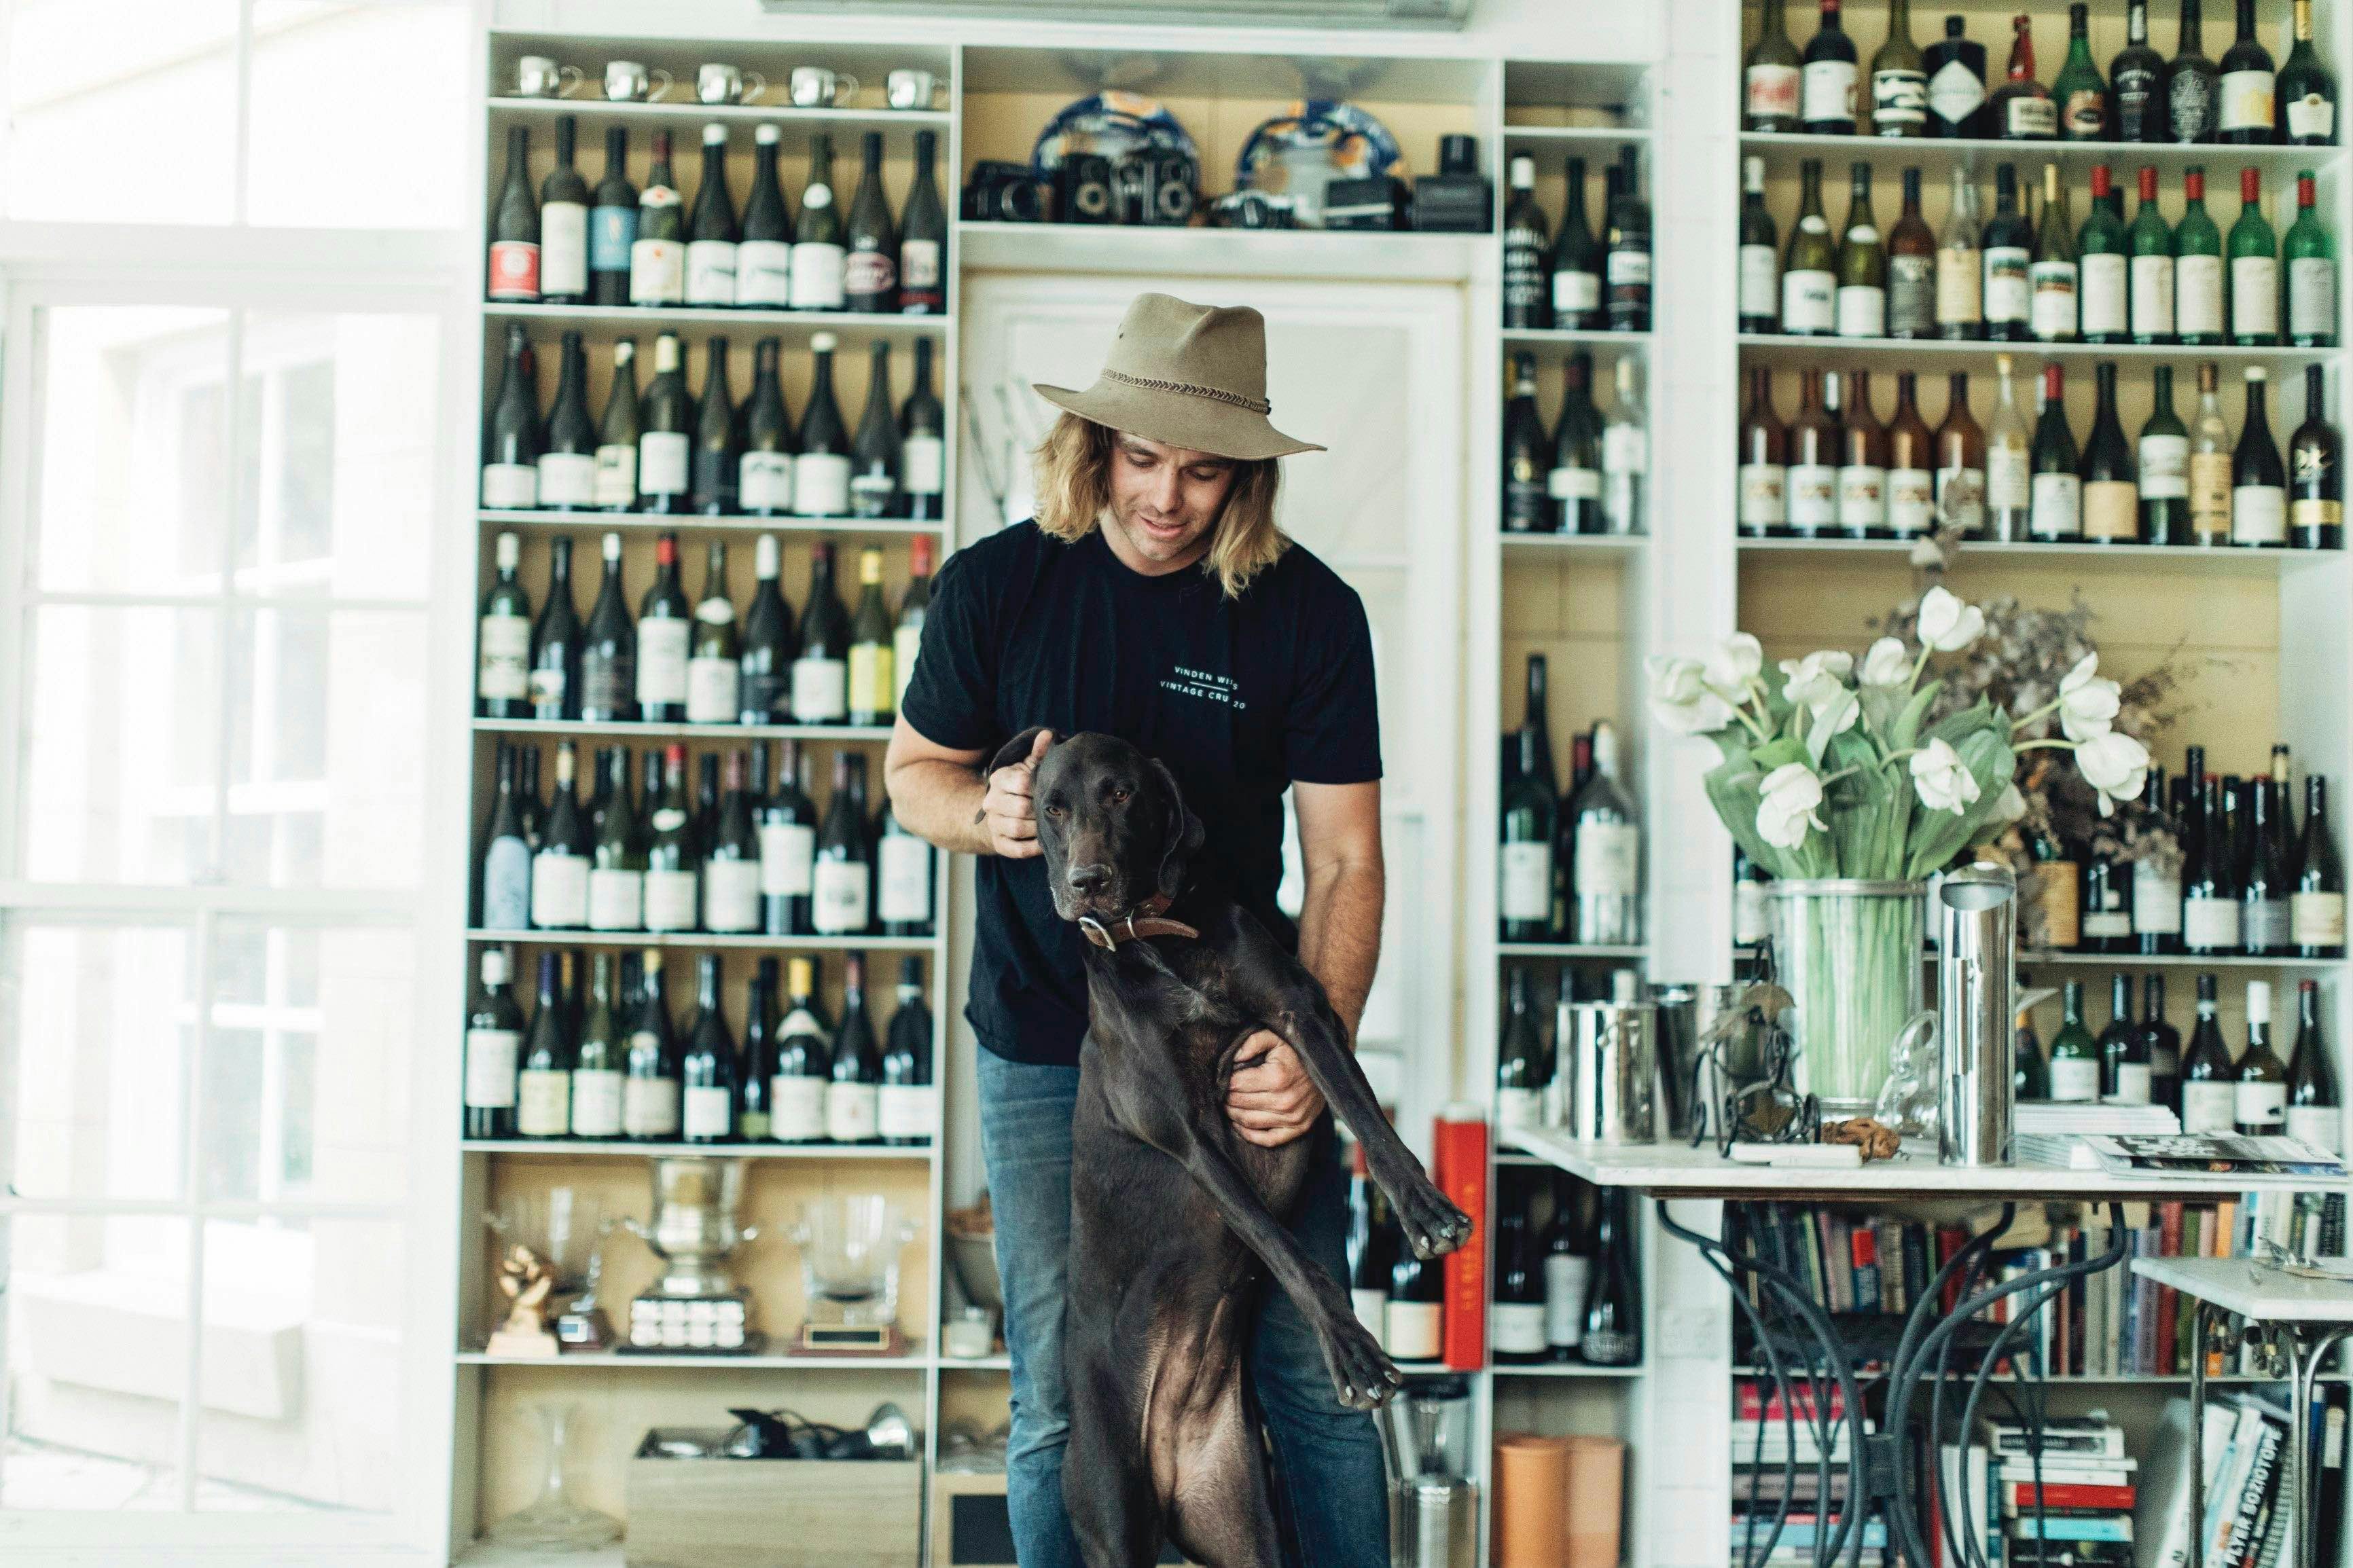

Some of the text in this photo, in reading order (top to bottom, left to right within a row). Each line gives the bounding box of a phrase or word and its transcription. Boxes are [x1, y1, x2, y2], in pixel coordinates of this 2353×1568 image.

[1174, 666, 1212, 681] VINDEN
[1160, 680, 1204, 697] VINTAGE
[1208, 692, 1229, 702] CRU
